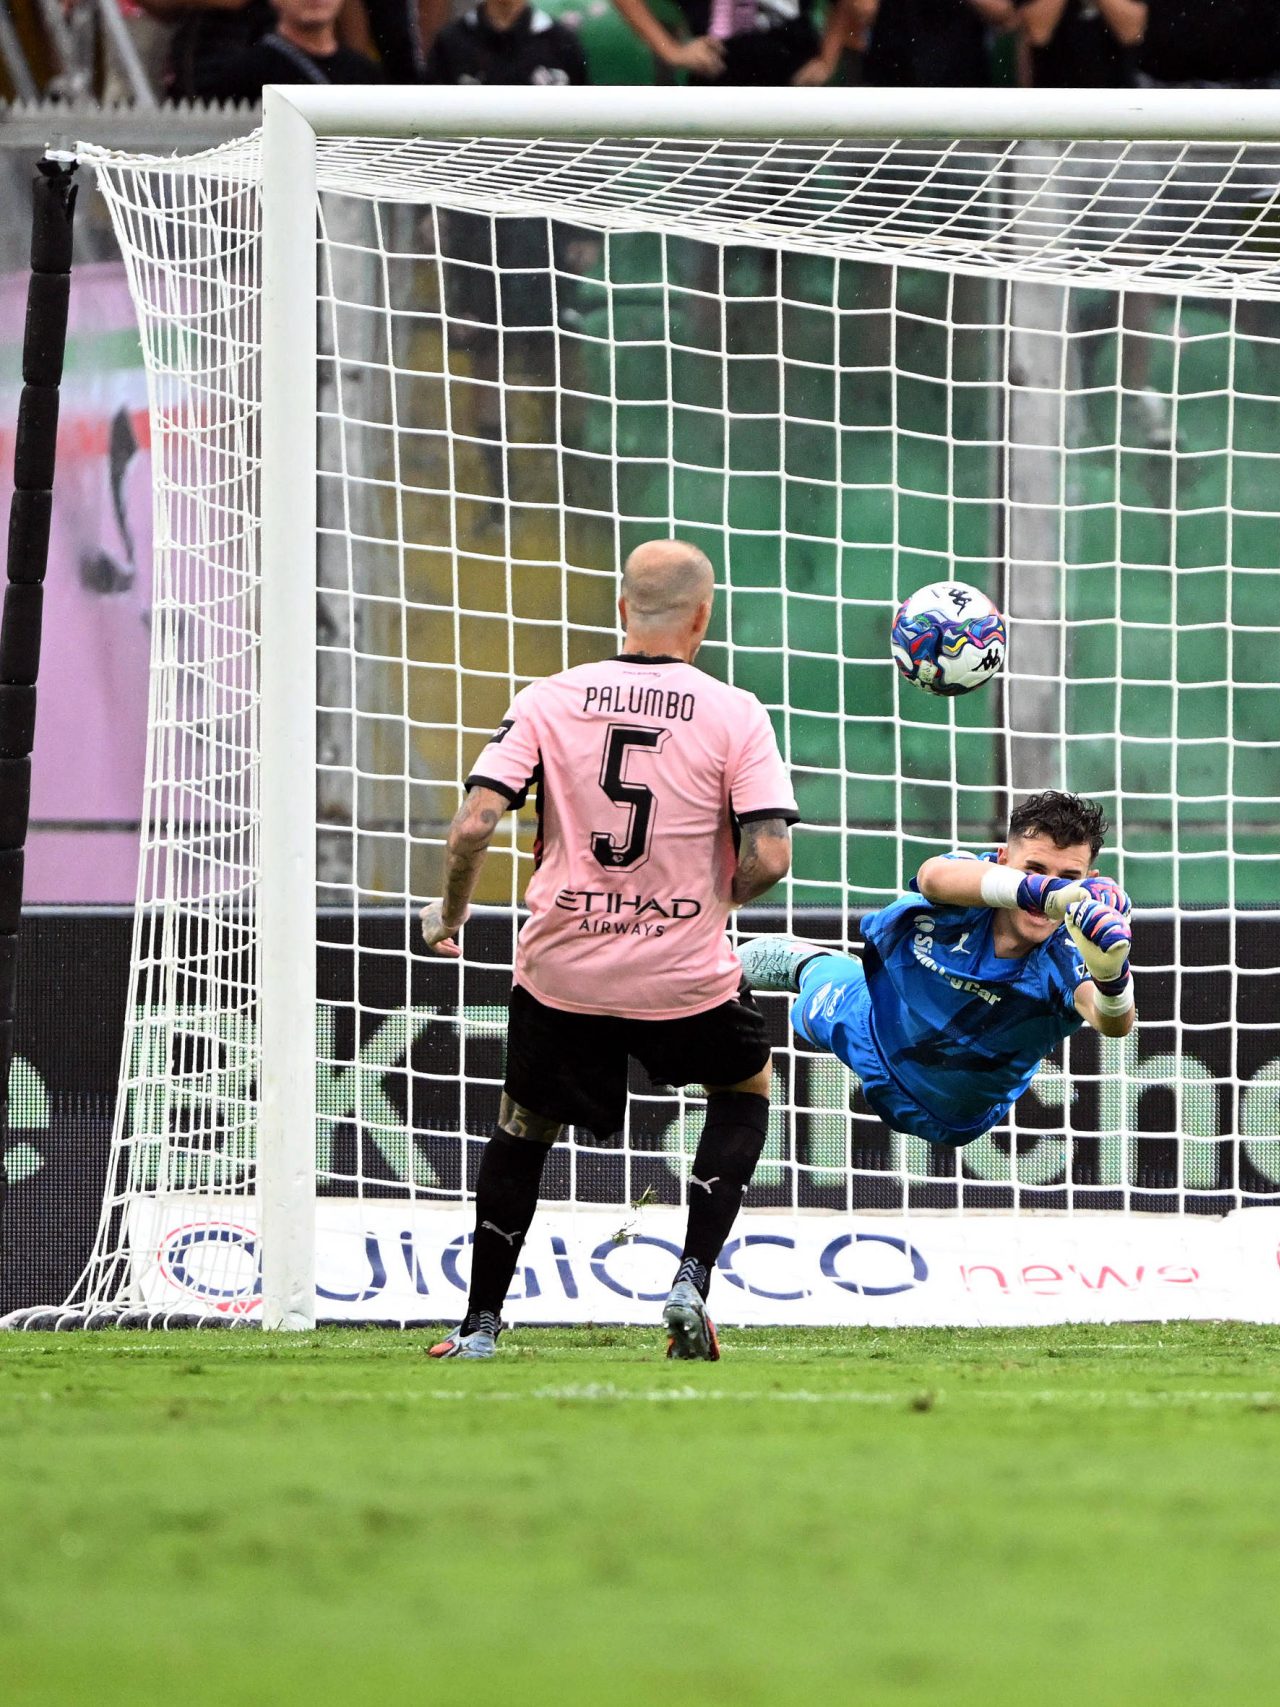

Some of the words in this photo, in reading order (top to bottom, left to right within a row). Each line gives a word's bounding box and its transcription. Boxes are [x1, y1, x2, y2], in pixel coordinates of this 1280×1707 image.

[582, 685, 696, 722] PALUMBO
[590, 722, 673, 874] 5
[555, 888, 702, 920] ETIHAD
[578, 917, 666, 937] AIRWAYS
[959, 1264, 1200, 1296] news
